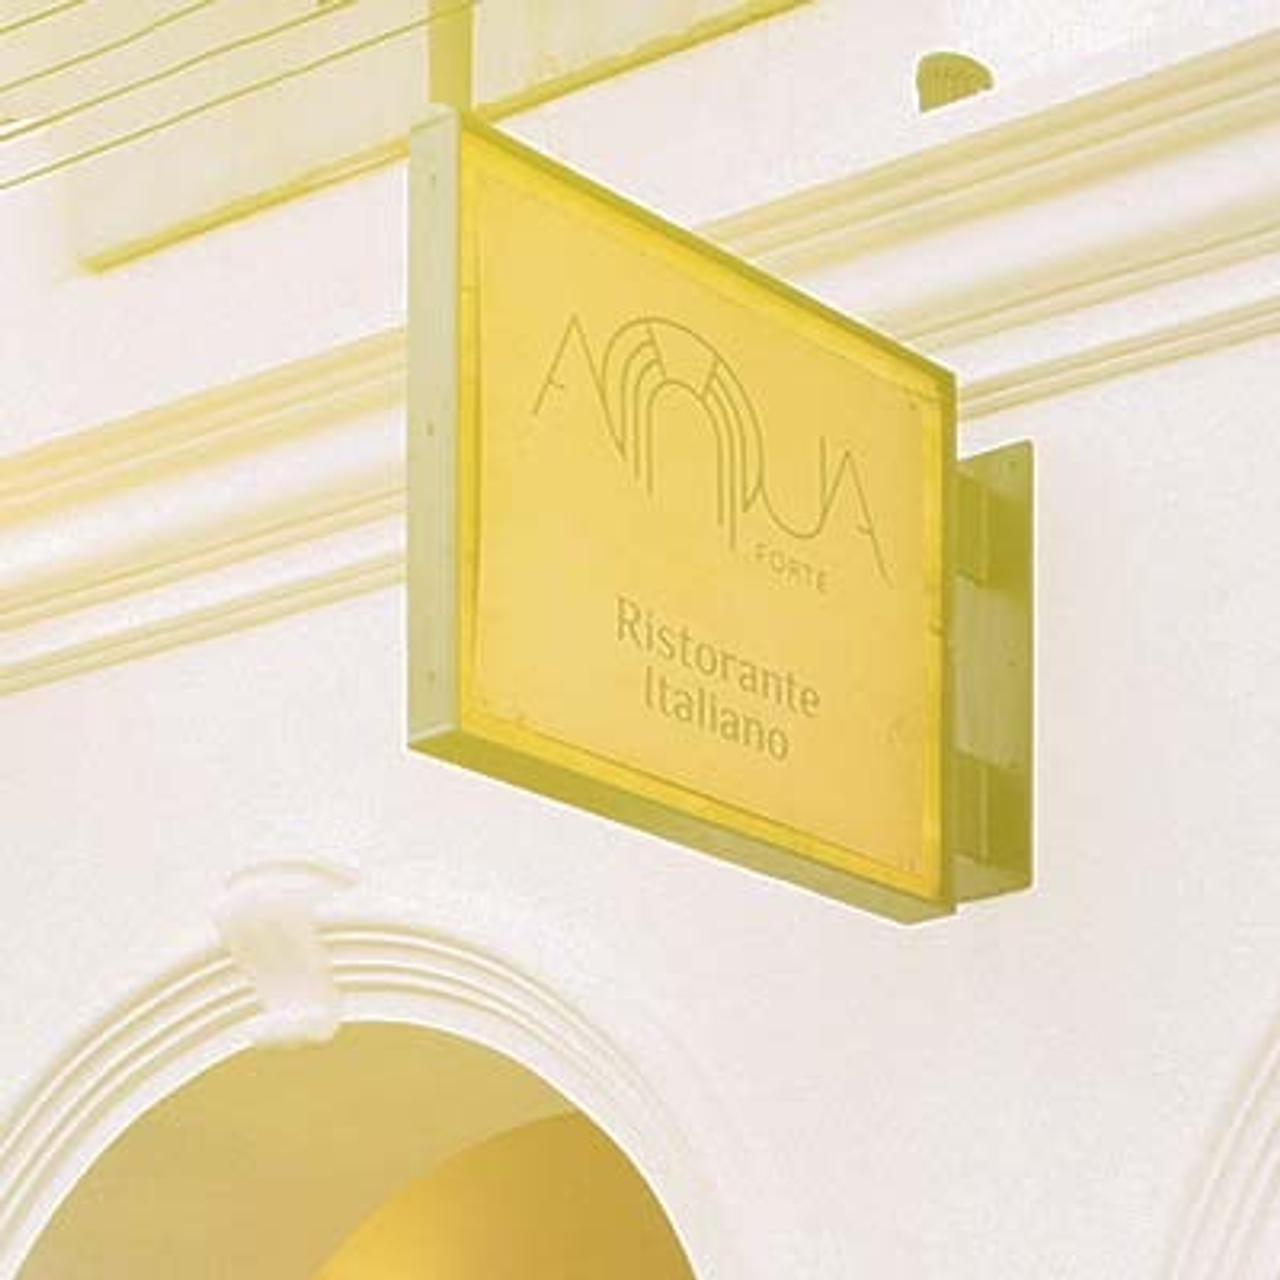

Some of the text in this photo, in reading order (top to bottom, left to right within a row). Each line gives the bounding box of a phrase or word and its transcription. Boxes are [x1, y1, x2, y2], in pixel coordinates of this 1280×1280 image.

[754, 542, 829, 593] FORTE
[615, 596, 821, 719] Ristorante
[645, 664, 790, 762] Italiano
